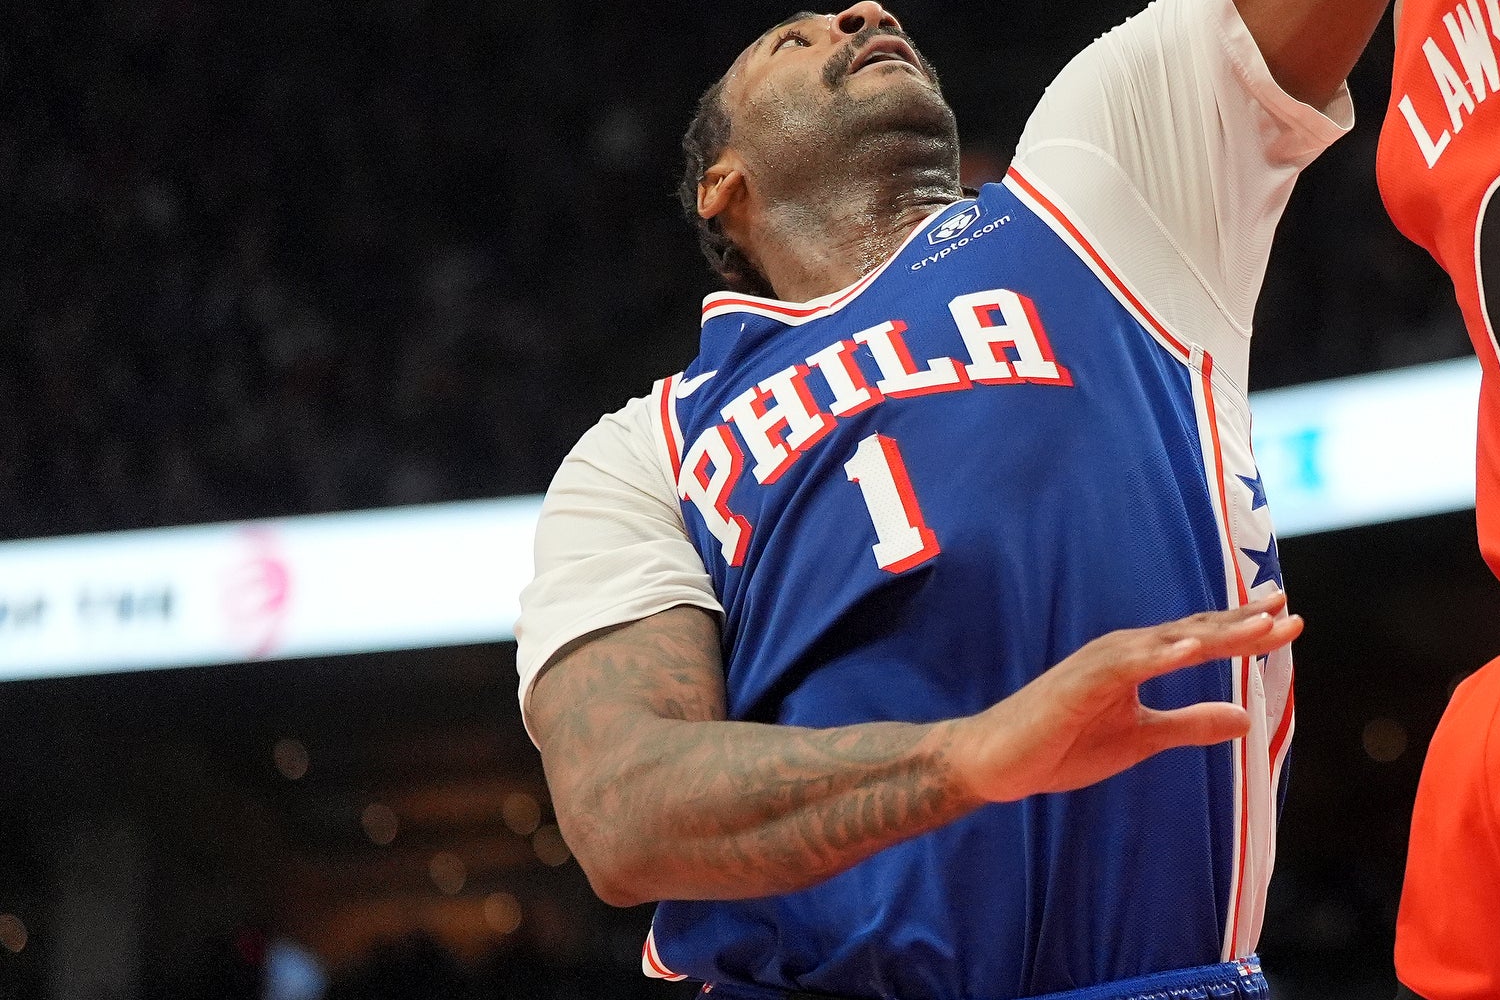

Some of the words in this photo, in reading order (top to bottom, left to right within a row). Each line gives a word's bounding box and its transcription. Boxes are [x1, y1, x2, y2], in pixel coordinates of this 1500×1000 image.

[911, 214, 1011, 271] crypto.com
[677, 288, 1074, 567] PHILA
[843, 431, 941, 574] 1
